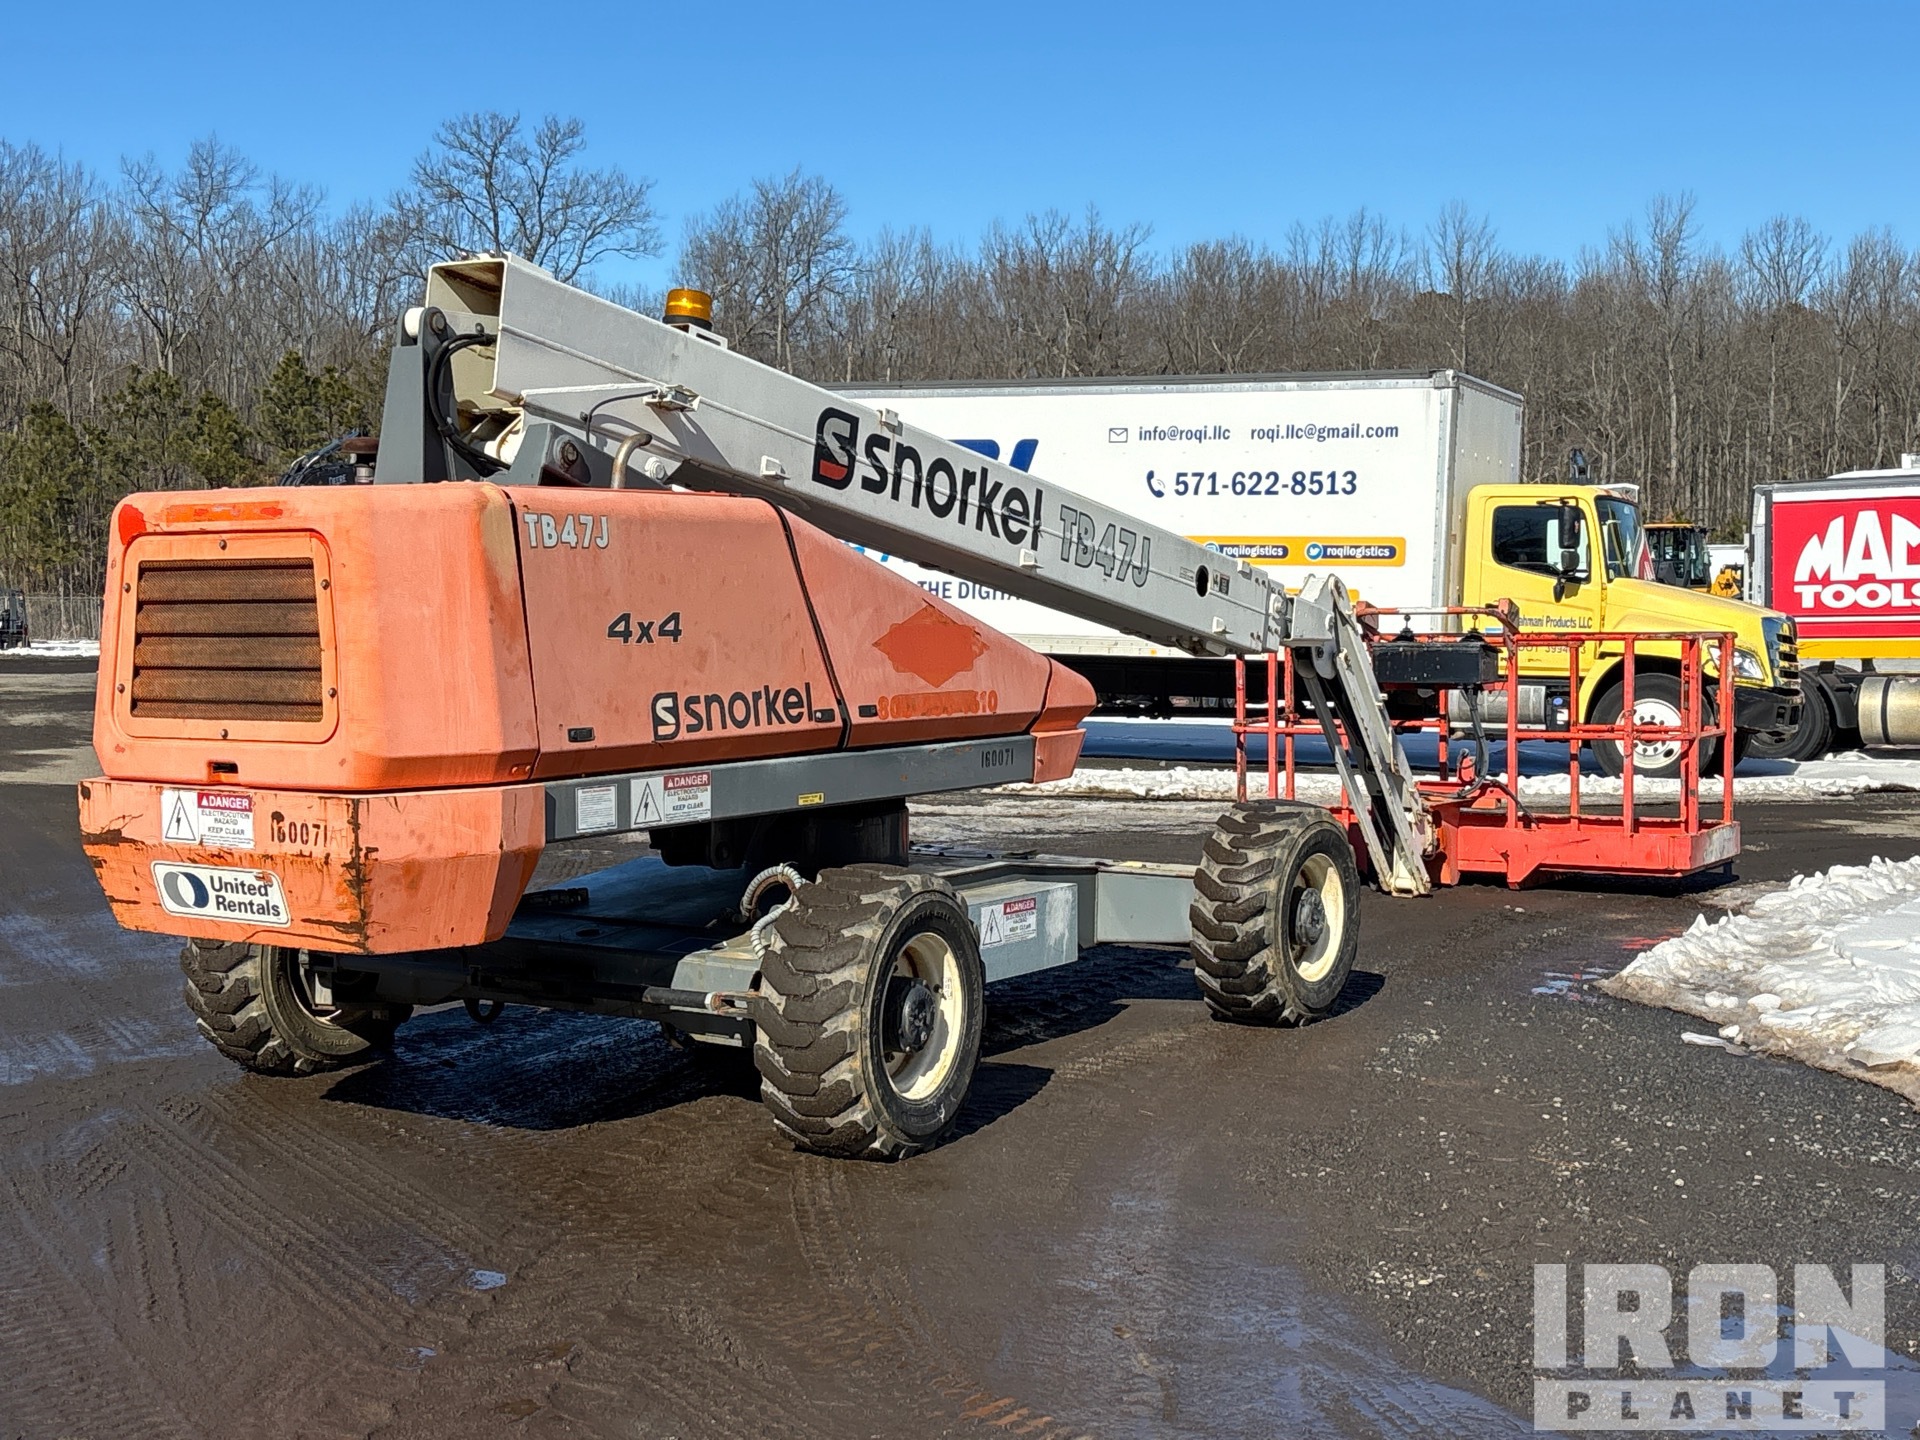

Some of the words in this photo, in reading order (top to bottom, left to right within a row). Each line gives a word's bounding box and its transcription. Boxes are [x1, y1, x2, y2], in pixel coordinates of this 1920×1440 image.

[1138, 425, 1231, 444] info@roqi.llc
[1250, 423, 1399, 443] roqi.llc@gmail.com
[861, 433, 1043, 551] snorkel
[1174, 470, 1358, 496] 571-622-8513
[523, 513, 609, 549] TB47J
[1060, 504, 1150, 588] TB47J
[1222, 545, 1284, 559] roqilogistics
[1326, 545, 1390, 559] roqilogistics
[607, 611, 683, 645] 4x4
[1545, 615, 1577, 628] Products
[1578, 616, 1593, 629] LLC
[684, 682, 814, 734] snorkel
[674, 775, 708, 787] DANGER
[208, 795, 250, 810] DANGER
[207, 826, 223, 834] KEEP
[224, 827, 246, 836] CLEAR
[209, 875, 269, 897] United
[215, 894, 281, 917] Rentals
[1010, 900, 1034, 911] DANGER
